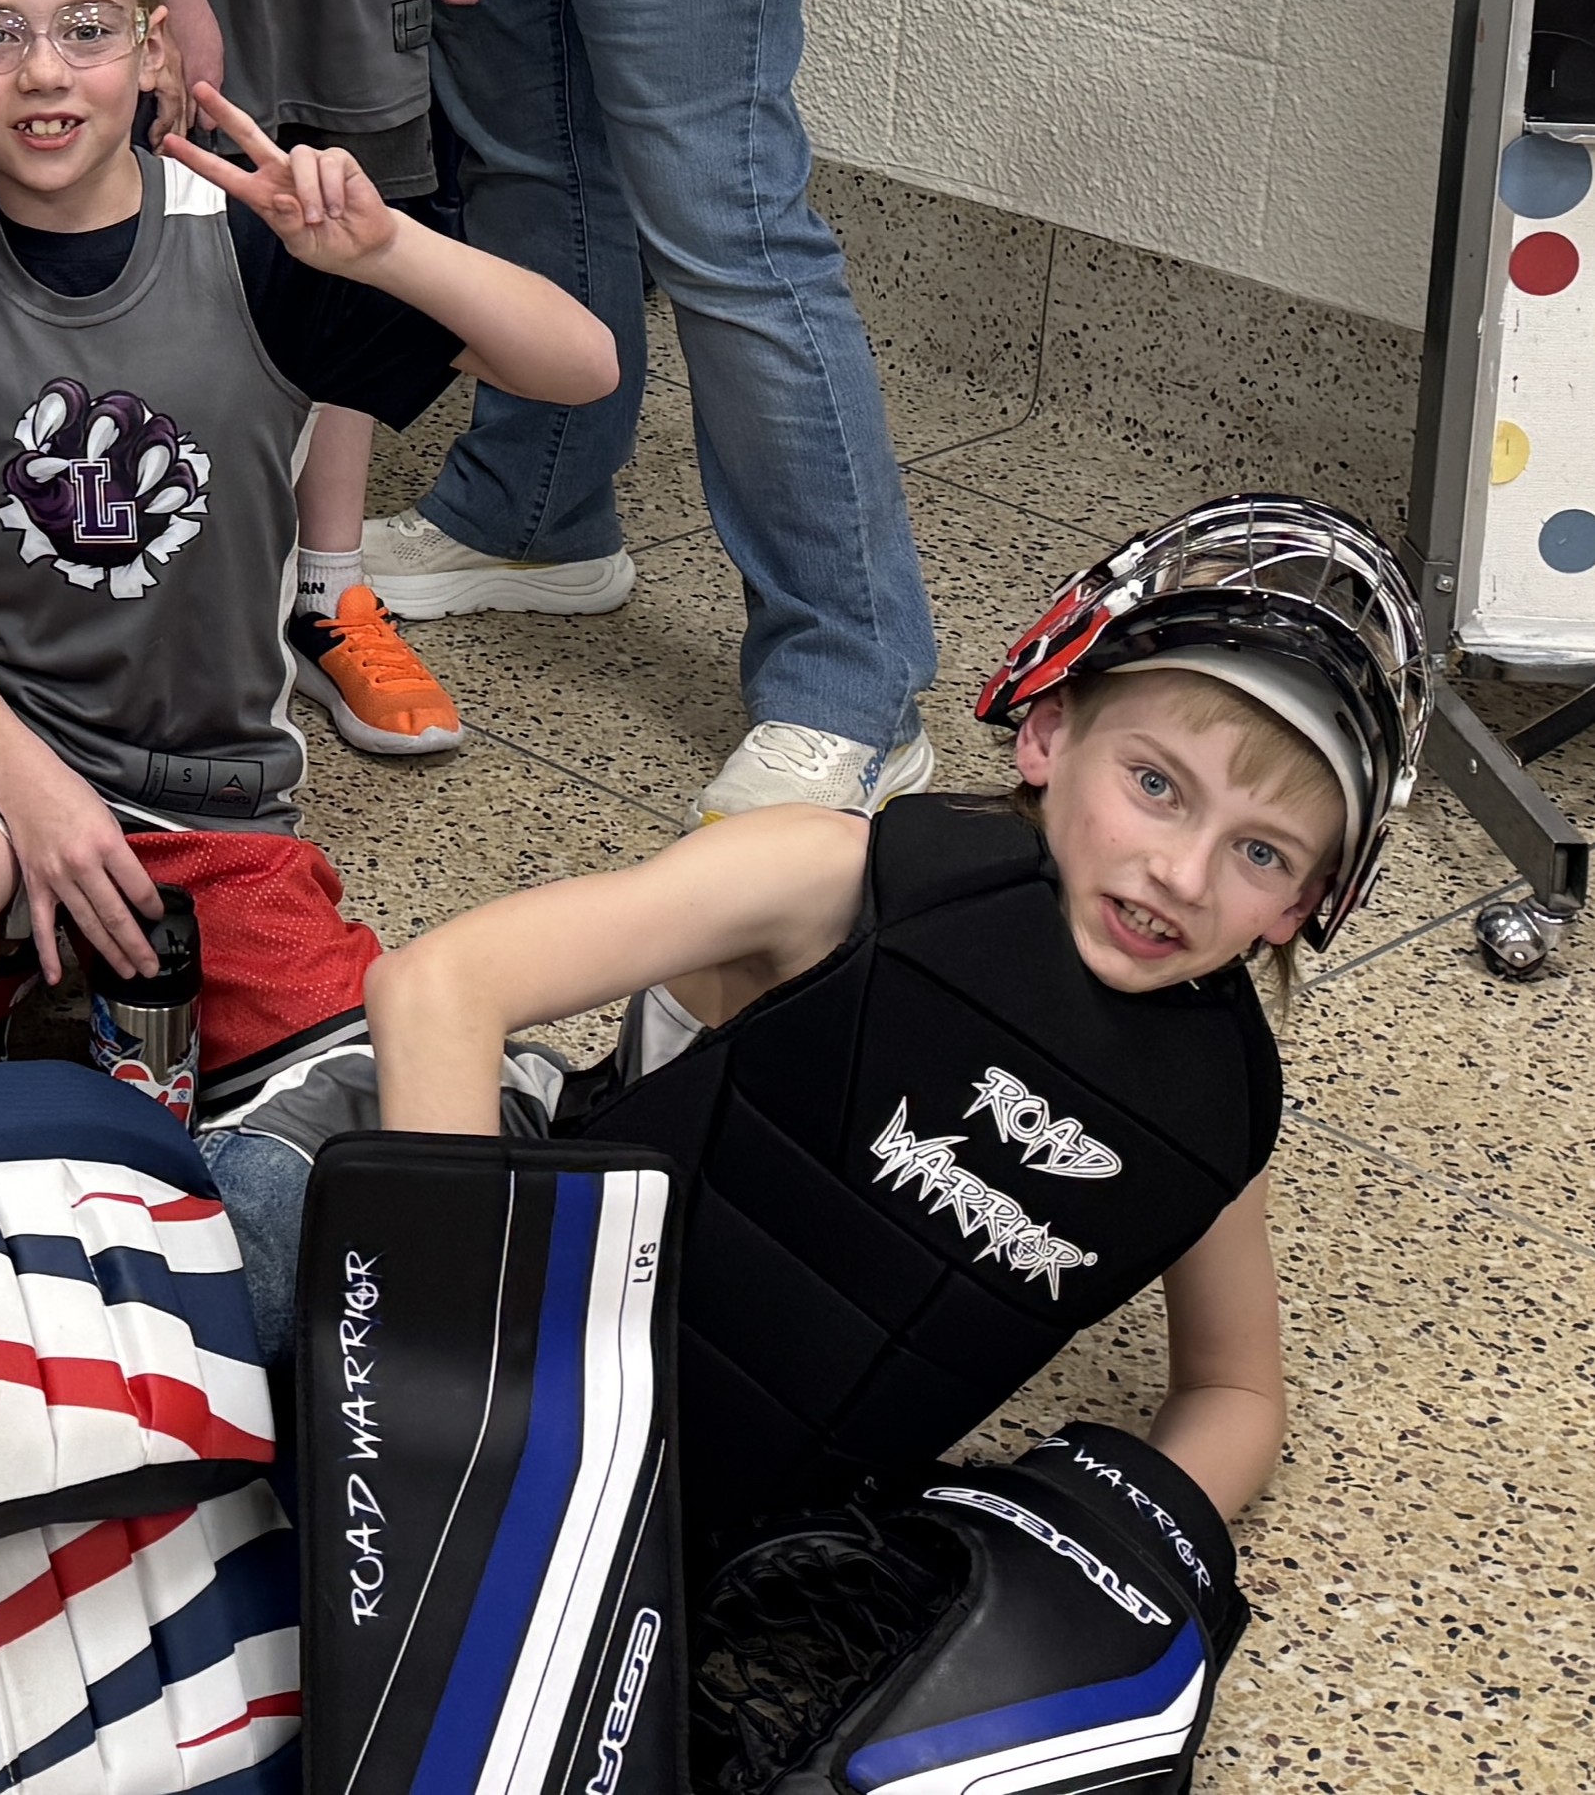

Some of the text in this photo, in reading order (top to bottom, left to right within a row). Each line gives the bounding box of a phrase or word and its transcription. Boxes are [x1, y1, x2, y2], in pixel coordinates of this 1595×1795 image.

[68, 457, 139, 544] L
[182, 767, 193, 784] S
[961, 1065, 1123, 1179] ROAD
[632, 1240, 658, 1283] LPS
[339, 1249, 389, 1628] ROAD WARRIOR
[1073, 1447, 1215, 1593] WARRIOR
